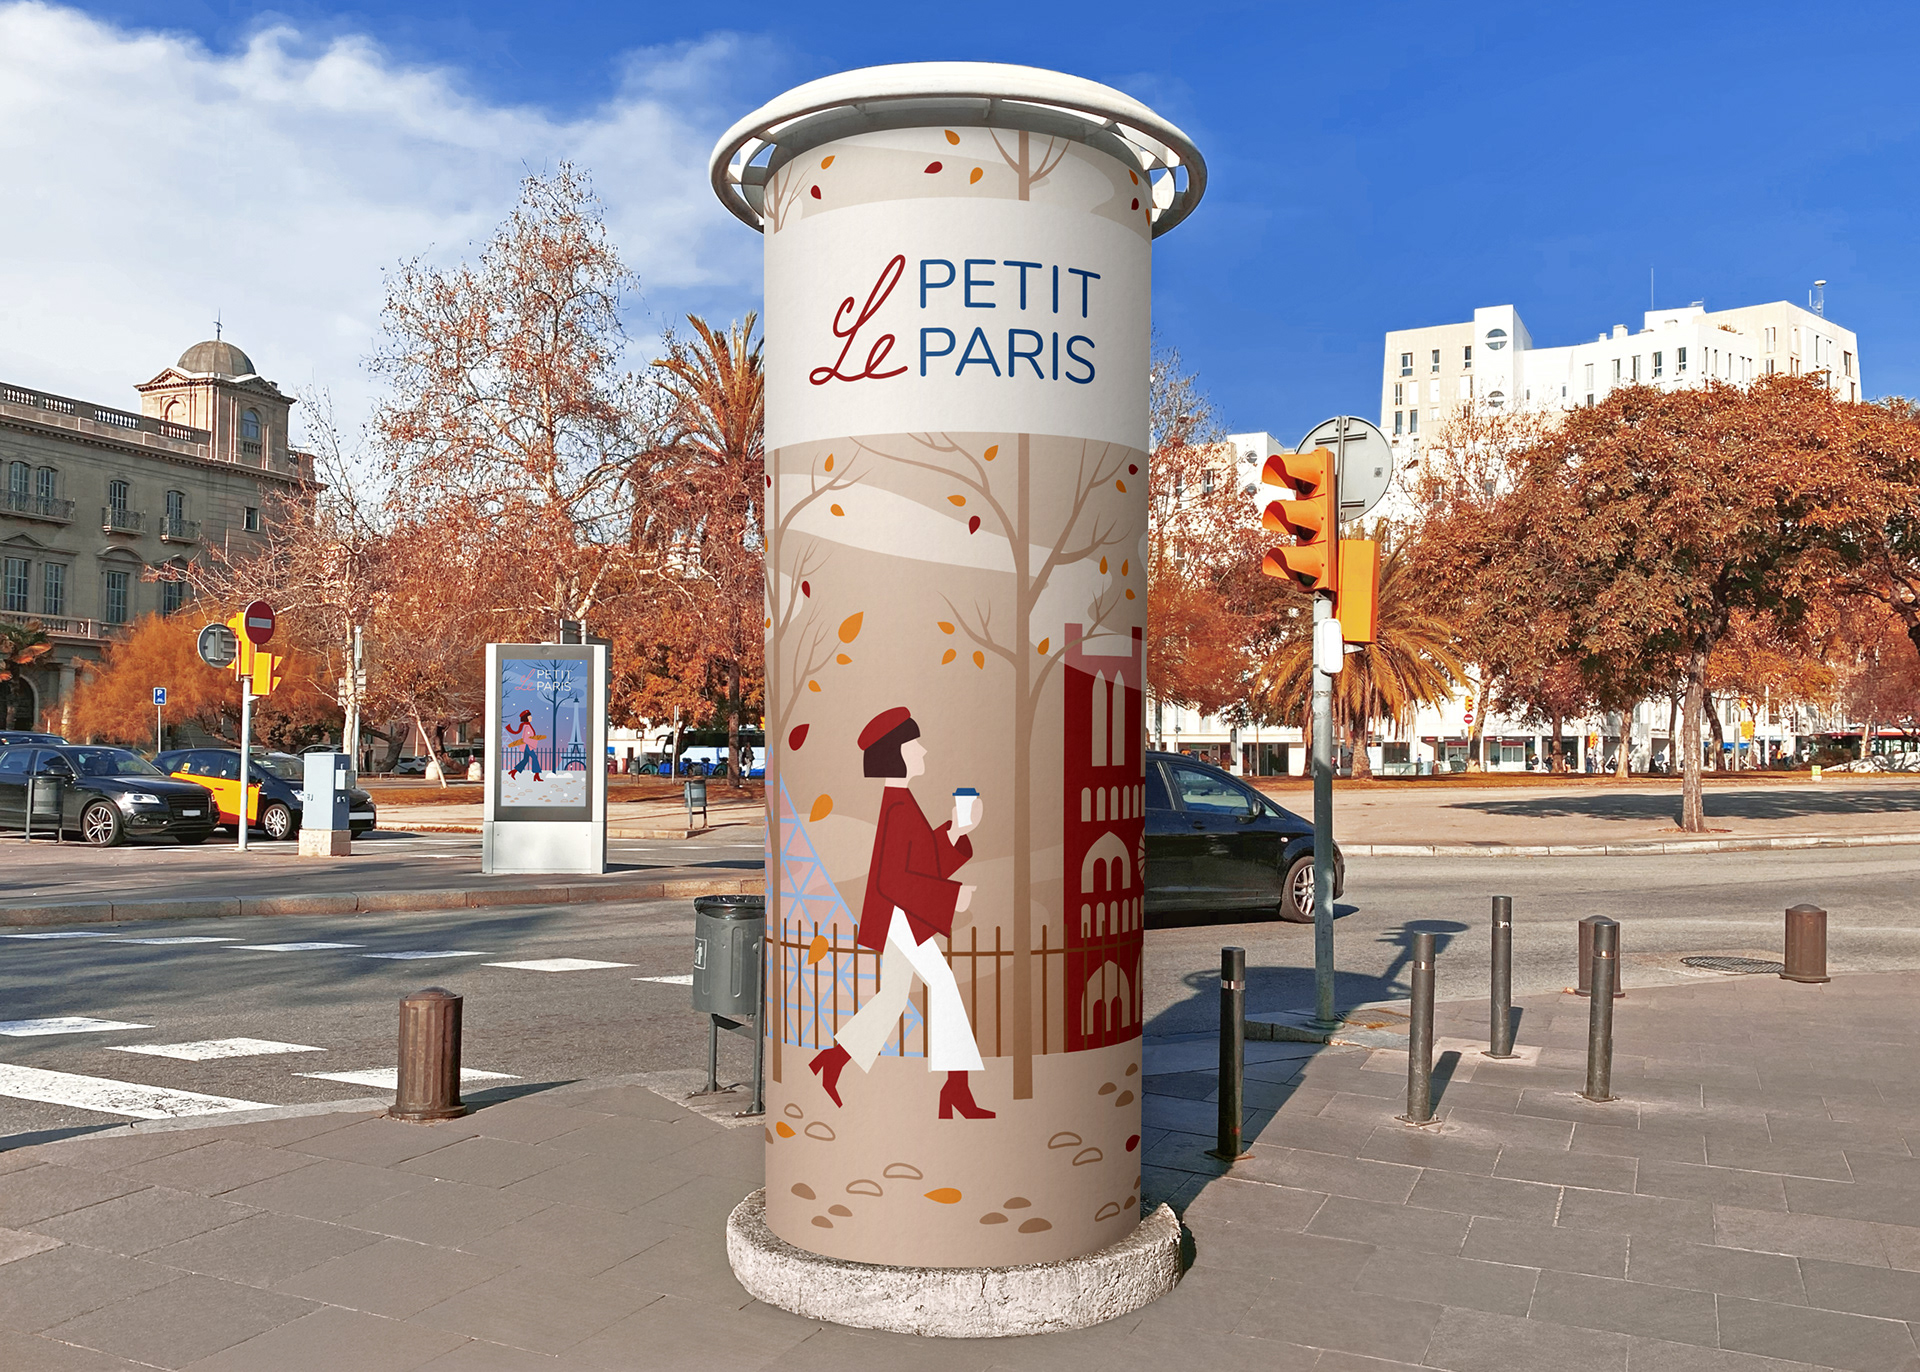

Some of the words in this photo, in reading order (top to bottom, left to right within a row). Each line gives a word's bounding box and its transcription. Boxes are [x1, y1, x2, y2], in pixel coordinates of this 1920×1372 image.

[809, 254, 908, 386] Le
[919, 258, 1101, 319] PETIT
[919, 326, 1096, 385] PARIS
[514, 668, 536, 691] Le
[536, 669, 573, 680] PETIT
[536, 681, 572, 692] PARIS
